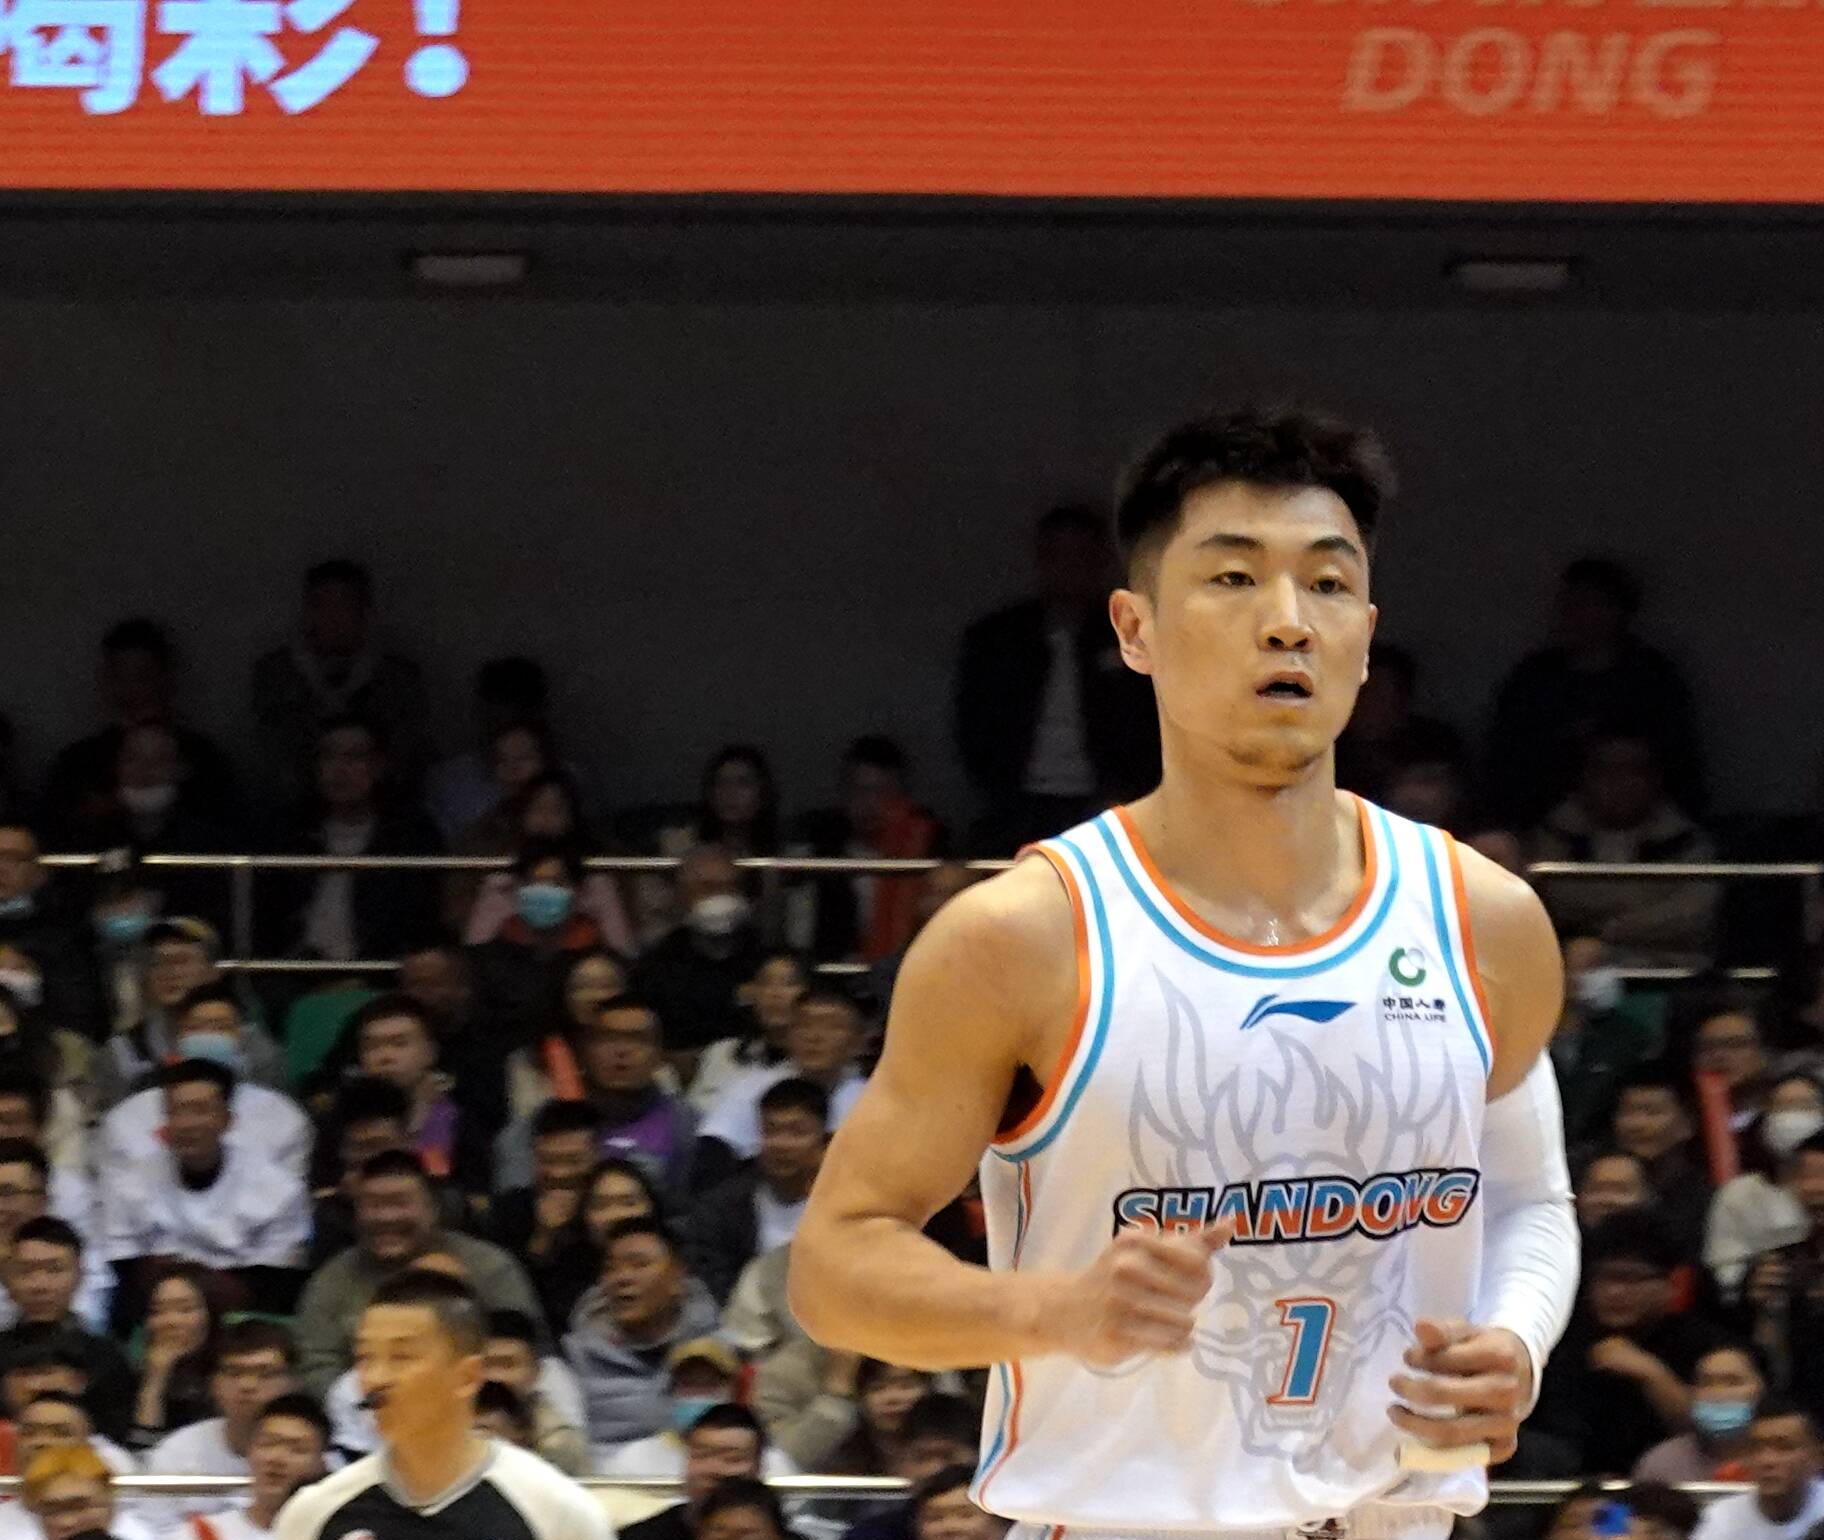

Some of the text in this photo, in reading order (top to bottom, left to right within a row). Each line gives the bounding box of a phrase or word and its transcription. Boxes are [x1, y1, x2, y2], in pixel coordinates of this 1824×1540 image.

[1339, 25, 1724, 118] DONG
[1384, 1013, 1421, 1021] CHINA
[1115, 1168, 1479, 1245] SHANDONG
[1265, 1296, 1336, 1405] 1
